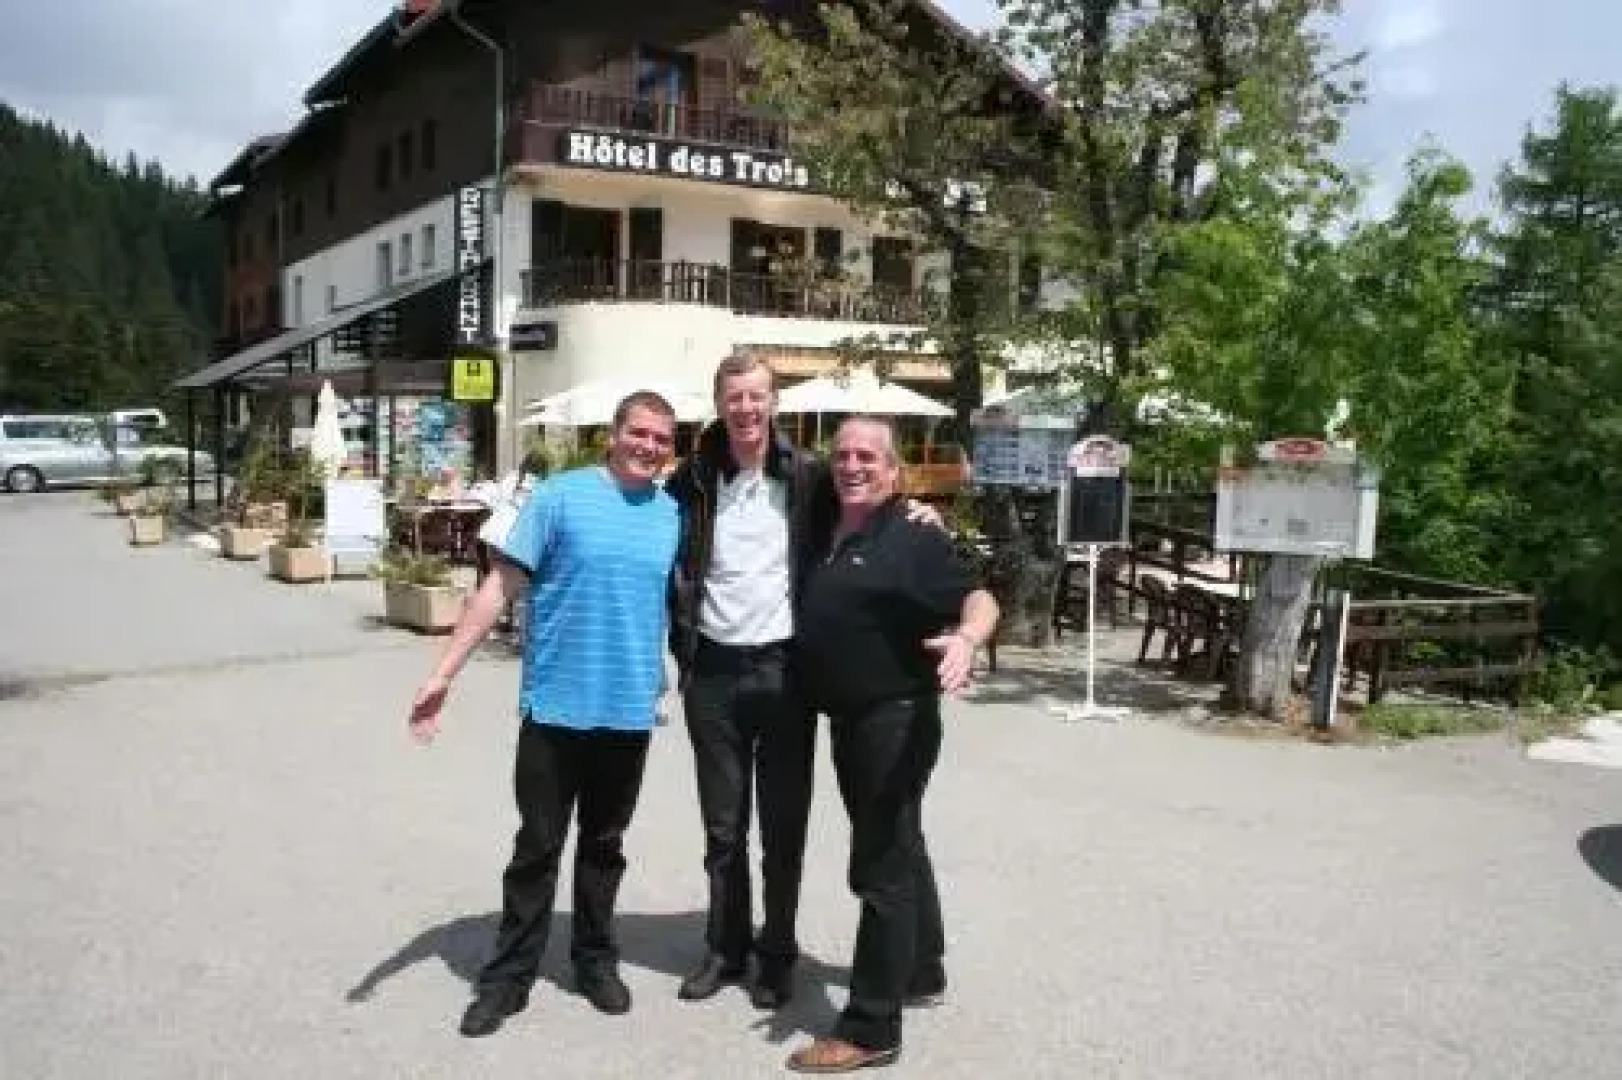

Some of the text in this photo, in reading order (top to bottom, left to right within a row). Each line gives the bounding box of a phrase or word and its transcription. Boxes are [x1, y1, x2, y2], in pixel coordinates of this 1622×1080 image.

[570, 132, 809, 187] Hôtel des Trois
